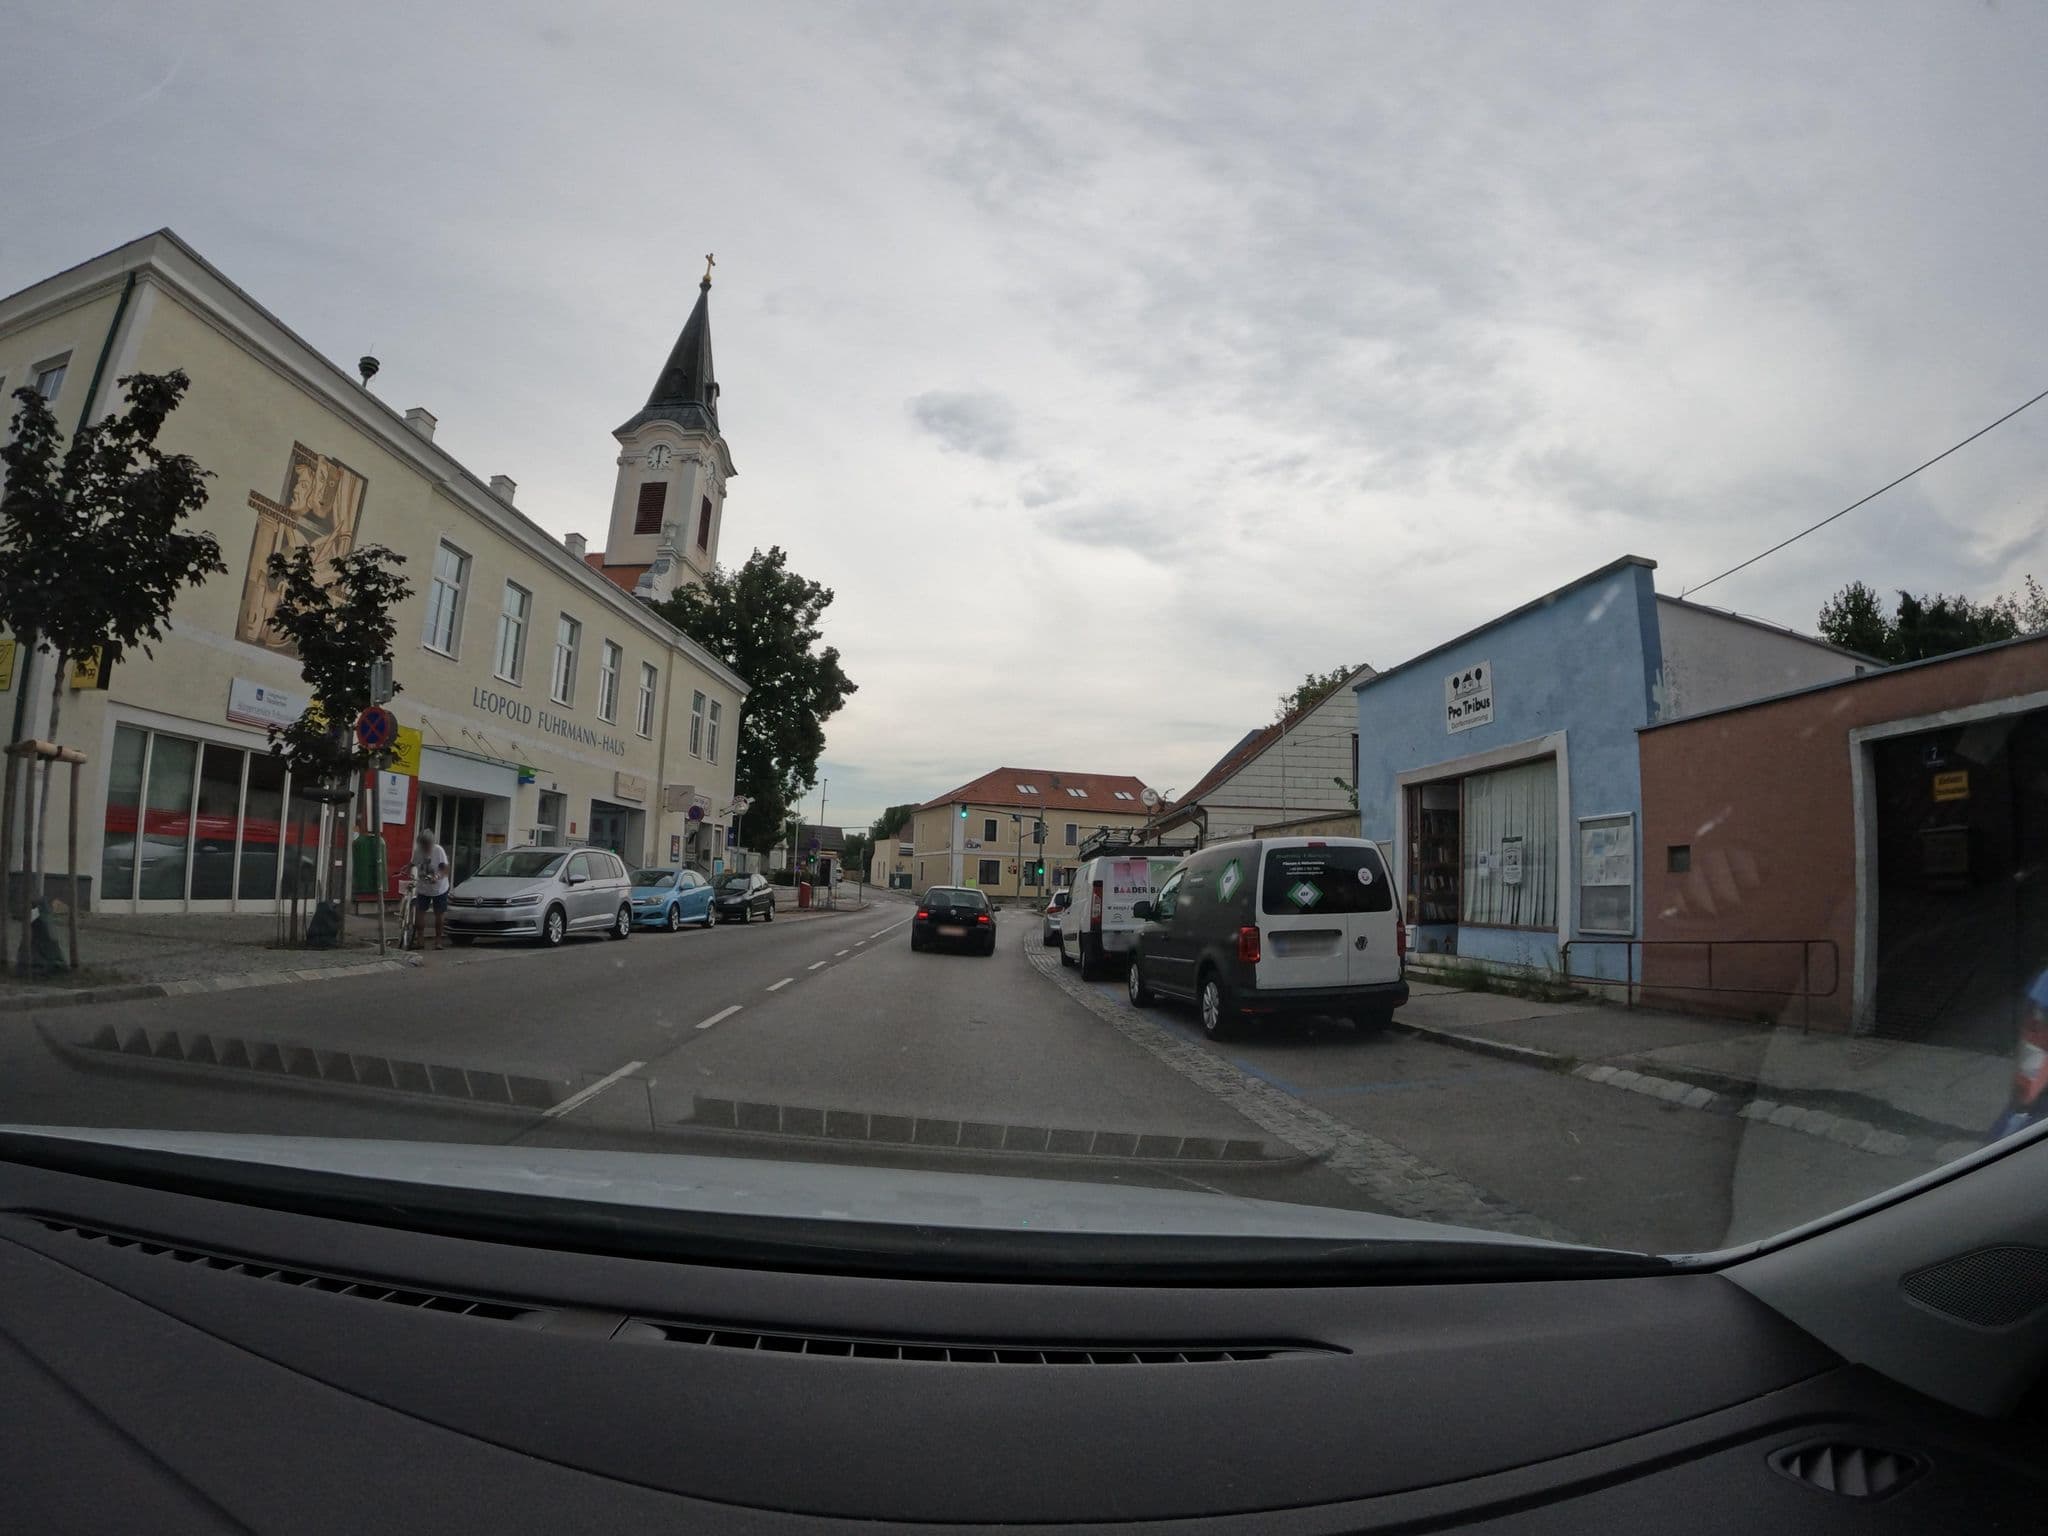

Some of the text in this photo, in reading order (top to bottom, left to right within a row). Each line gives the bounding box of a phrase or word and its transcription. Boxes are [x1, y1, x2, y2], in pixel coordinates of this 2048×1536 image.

[1448, 697, 1490, 720] Pro Tribus
[473, 686, 625, 756] LEOPOLD FUHRMANN-HAUS
[1114, 886, 1147, 894] BAADER
